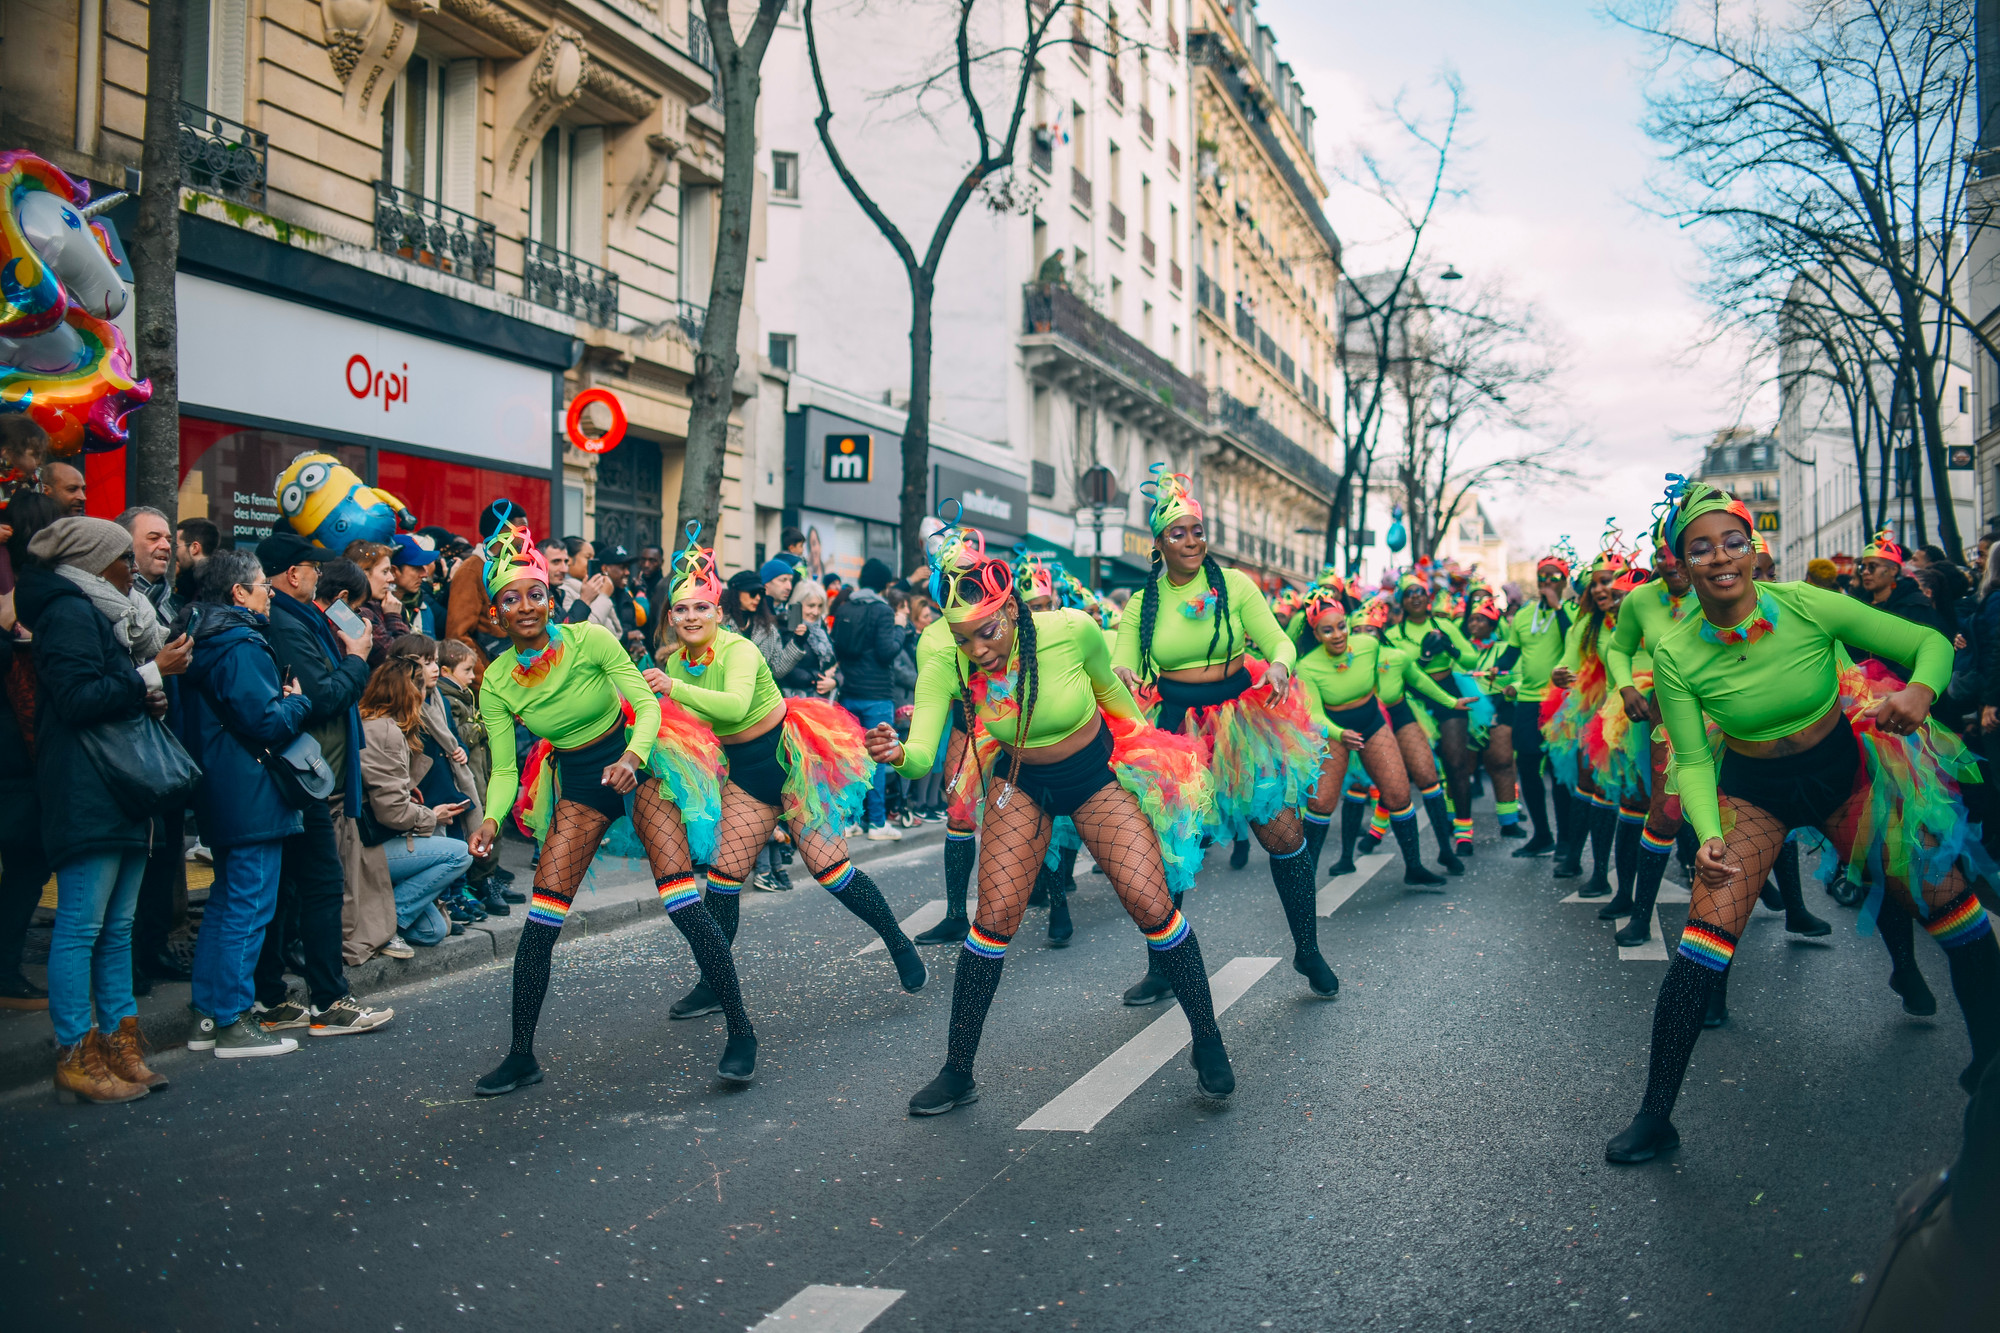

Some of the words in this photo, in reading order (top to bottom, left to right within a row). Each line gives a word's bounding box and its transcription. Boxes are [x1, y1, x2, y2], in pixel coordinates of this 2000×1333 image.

[345, 353, 408, 412] Orpi
[233, 491, 250, 504] Des
[251, 493, 278, 507] femme
[233, 507, 250, 519] des
[250, 508, 282, 522] homme
[233, 525, 254, 537] pour
